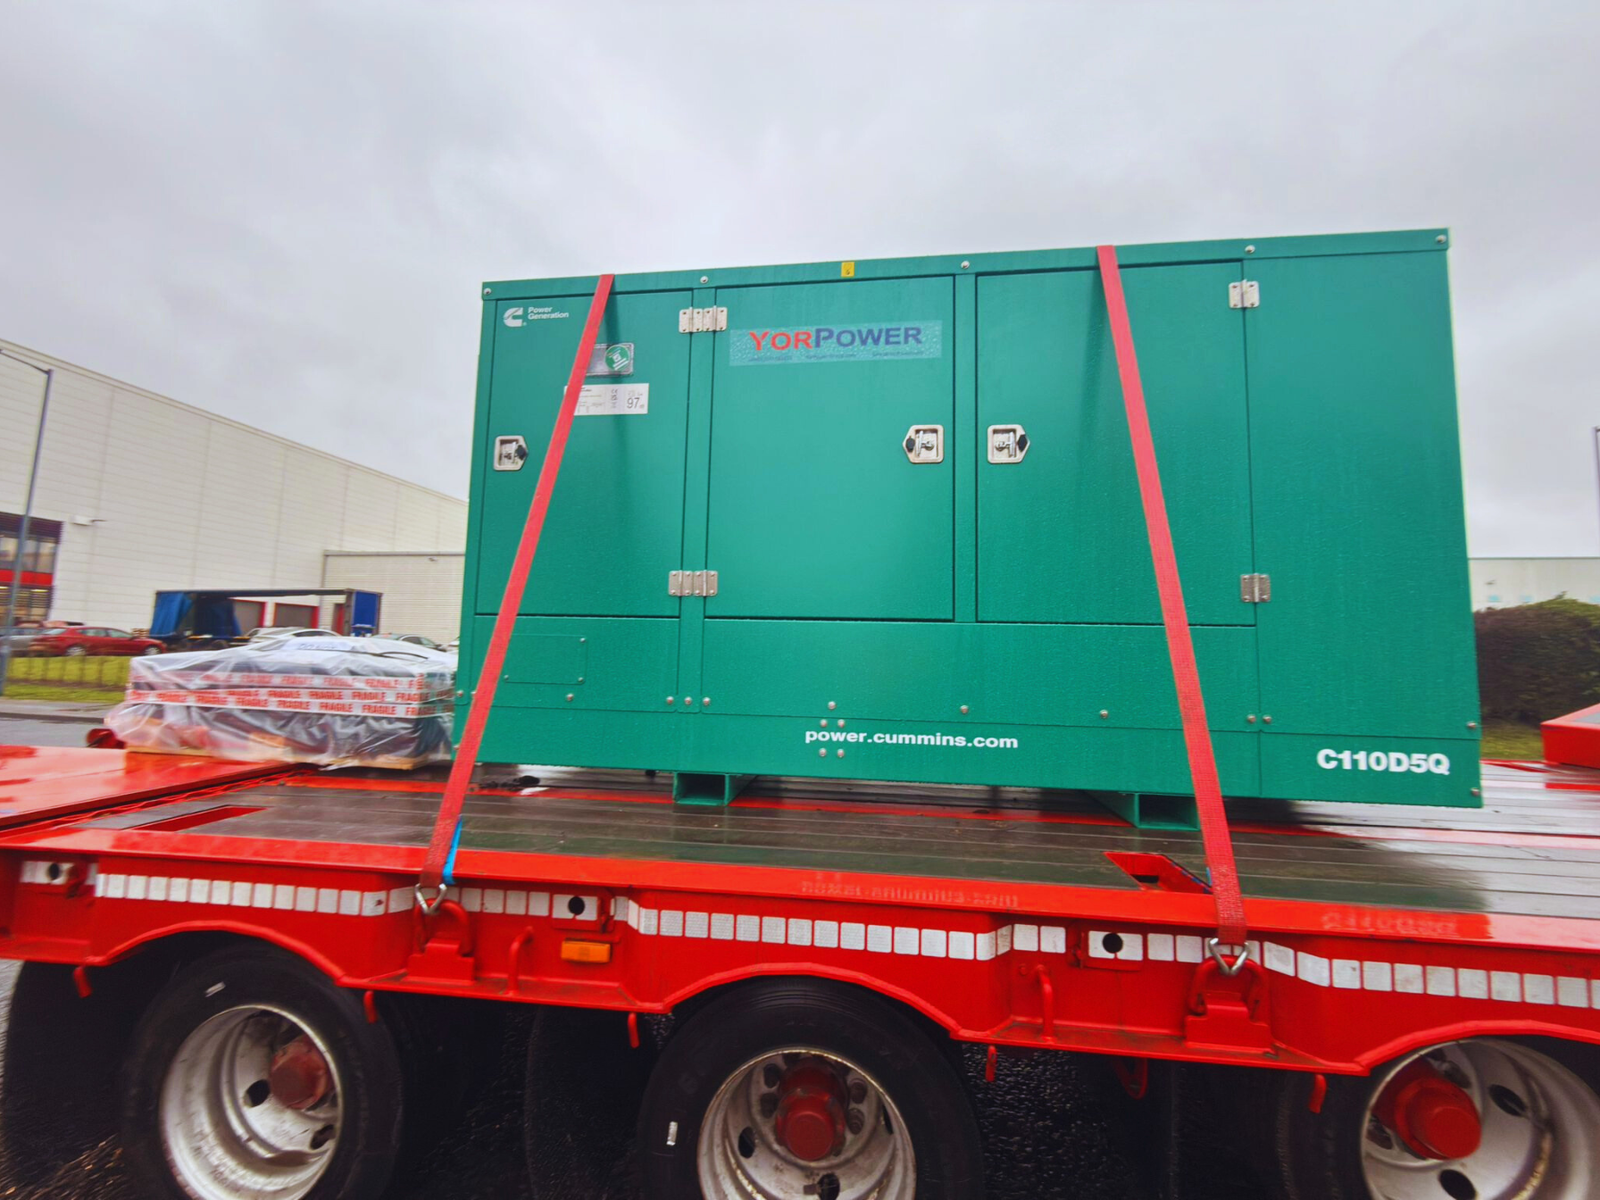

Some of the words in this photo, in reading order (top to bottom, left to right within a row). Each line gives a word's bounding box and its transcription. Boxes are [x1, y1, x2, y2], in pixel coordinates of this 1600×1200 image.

[528, 306, 553, 314] Power
[528, 311, 569, 320] Generation
[749, 326, 923, 351] YORPOWER
[626, 397, 640, 409] 97
[805, 730, 1018, 748] power.cummins.com
[1316, 748, 1450, 775] C110D5Q
